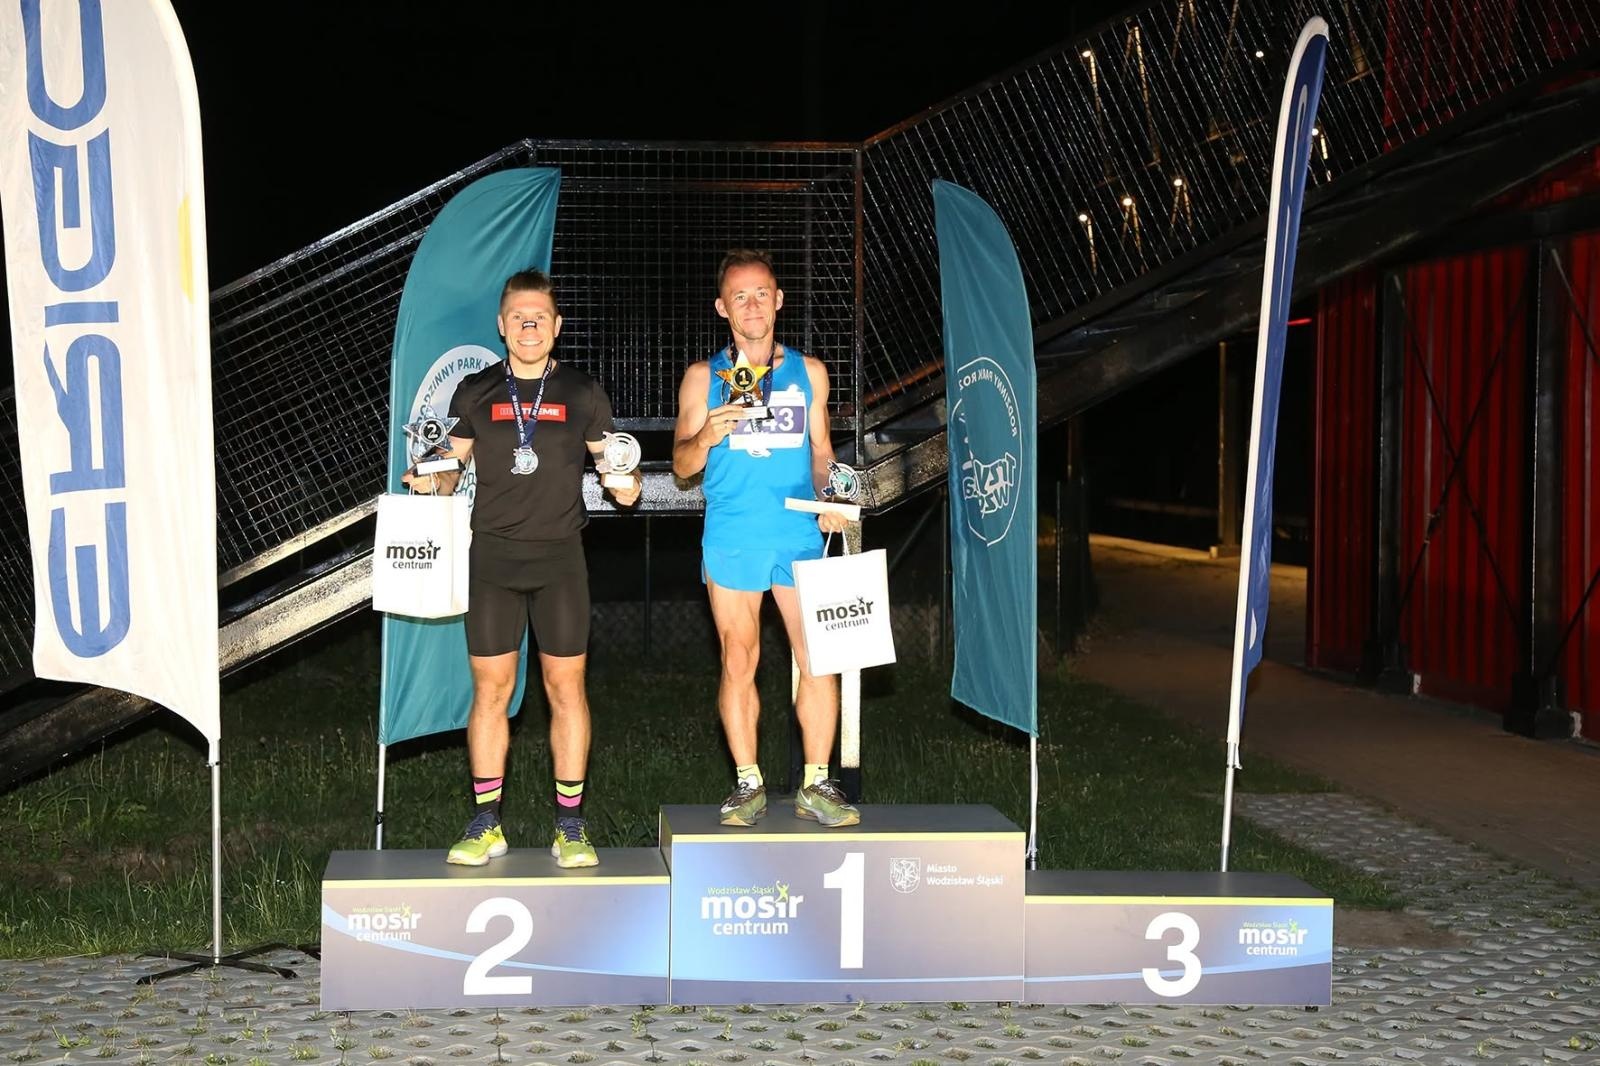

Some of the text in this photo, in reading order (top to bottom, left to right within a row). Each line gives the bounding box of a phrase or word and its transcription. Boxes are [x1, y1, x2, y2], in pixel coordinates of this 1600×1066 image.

[457, 357, 482, 370] PARK
[738, 370, 749, 385] 1
[427, 423, 438, 439] 2
[386, 545, 441, 560] mosir
[392, 560, 433, 569] centrum
[816, 600, 874, 623] mosir
[825, 617, 869, 631] centrum
[926, 864, 957, 873] Miasto
[701, 894, 804, 919] mosir
[823, 852, 865, 969] 1
[348, 912, 422, 930] mosir
[712, 920, 789, 936] centrum
[356, 930, 412, 942] centrum
[1239, 927, 1308, 945] mosir
[463, 897, 534, 996] 2
[1142, 911, 1202, 997] 3
[1246, 945, 1297, 955] centrum
